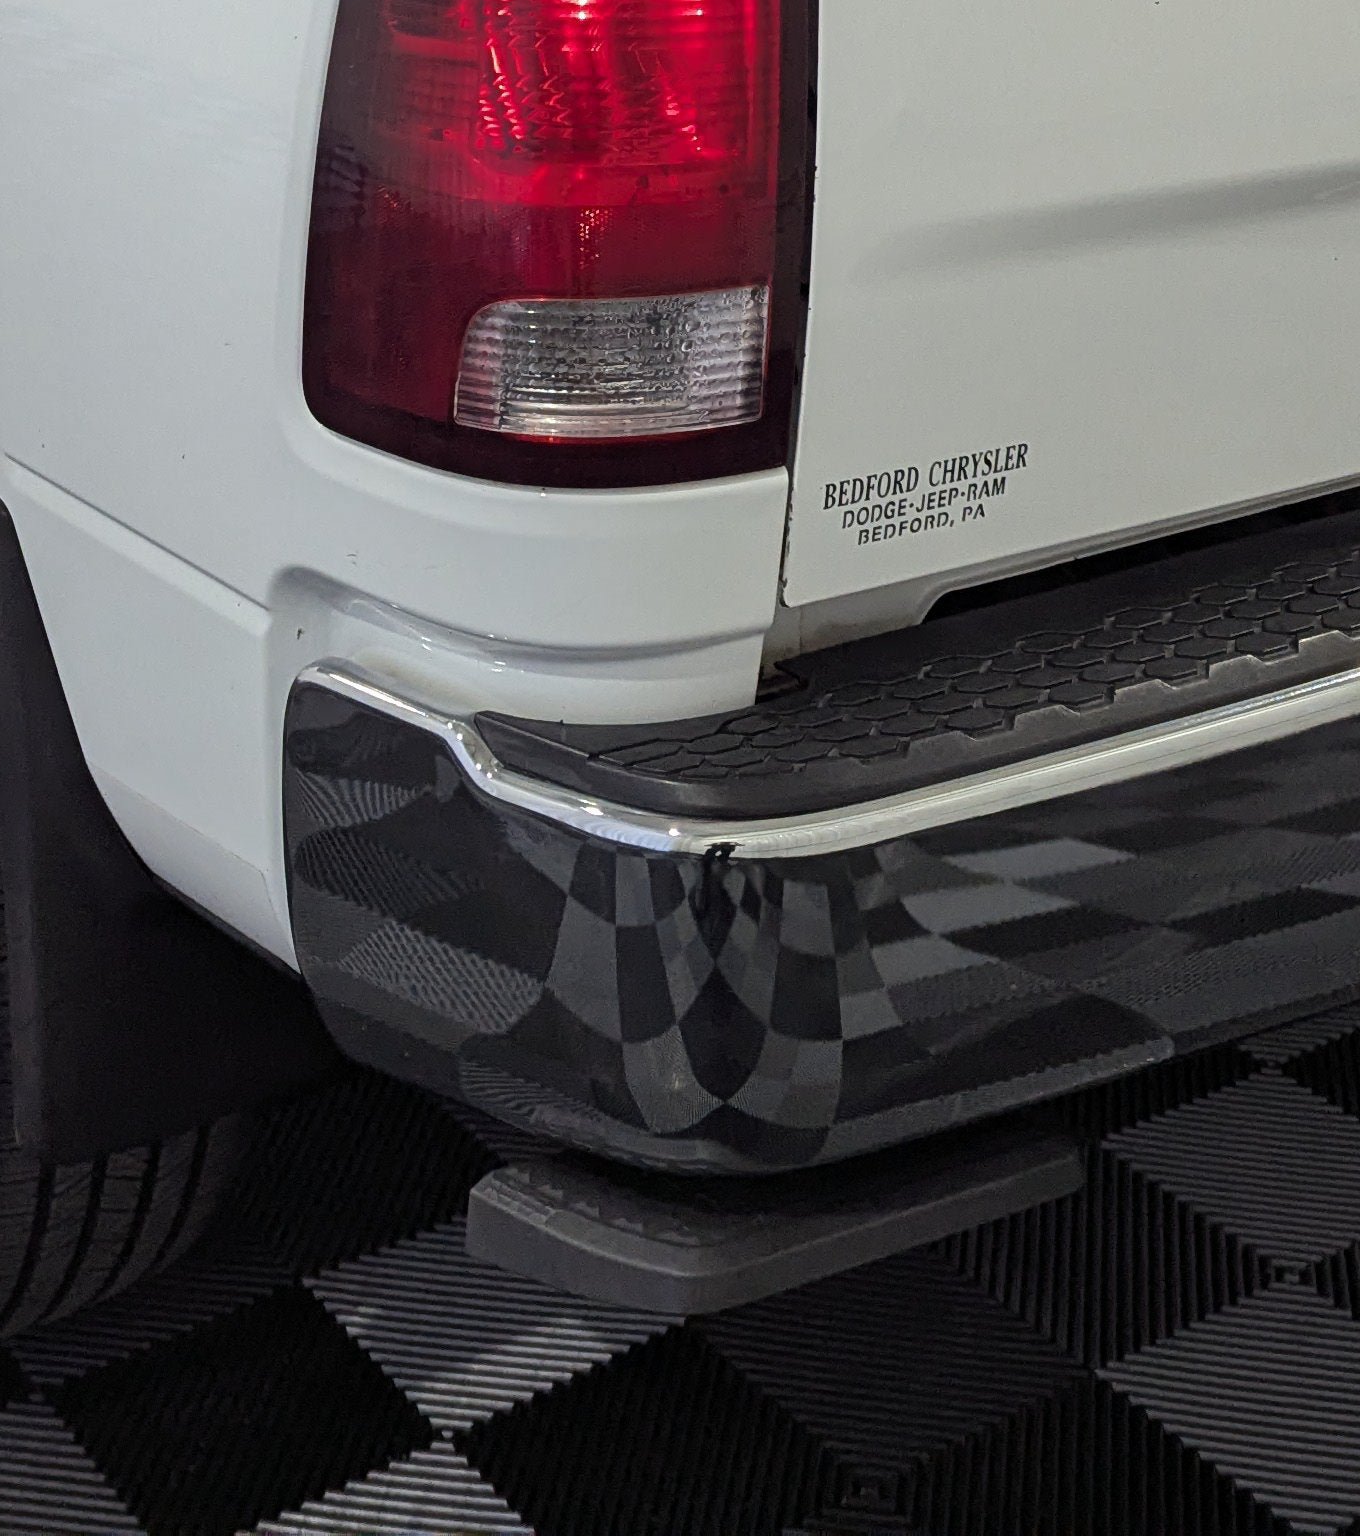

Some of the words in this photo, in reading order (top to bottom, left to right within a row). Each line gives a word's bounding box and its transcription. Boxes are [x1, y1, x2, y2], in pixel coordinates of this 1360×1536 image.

[822, 466, 920, 511] BEDFORD
[928, 442, 1030, 488] CHRYSLER
[856, 511, 955, 546] BEDFORD,
[961, 503, 987, 523] PA
